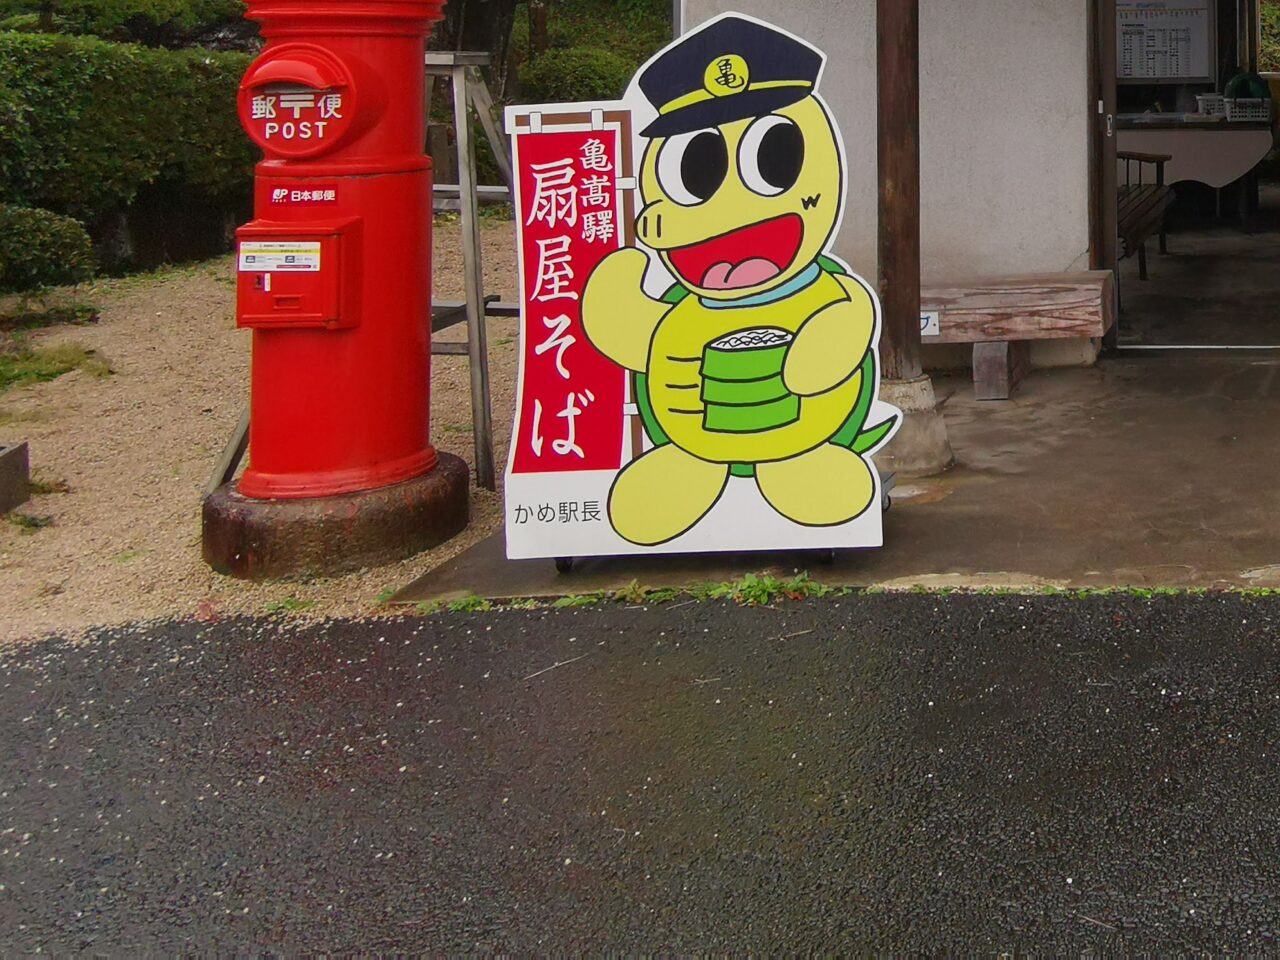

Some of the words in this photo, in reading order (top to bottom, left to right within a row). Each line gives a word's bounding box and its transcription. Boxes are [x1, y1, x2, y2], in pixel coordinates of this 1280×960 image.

[714, 58, 745, 89] 亀
[265, 121, 328, 139] POST
[291, 190, 335, 202] 日本郵便
[579, 138, 614, 244] 亀嵩驛
[526, 158, 594, 459] 扇屋そば
[514, 500, 601, 524] かめ駅長
